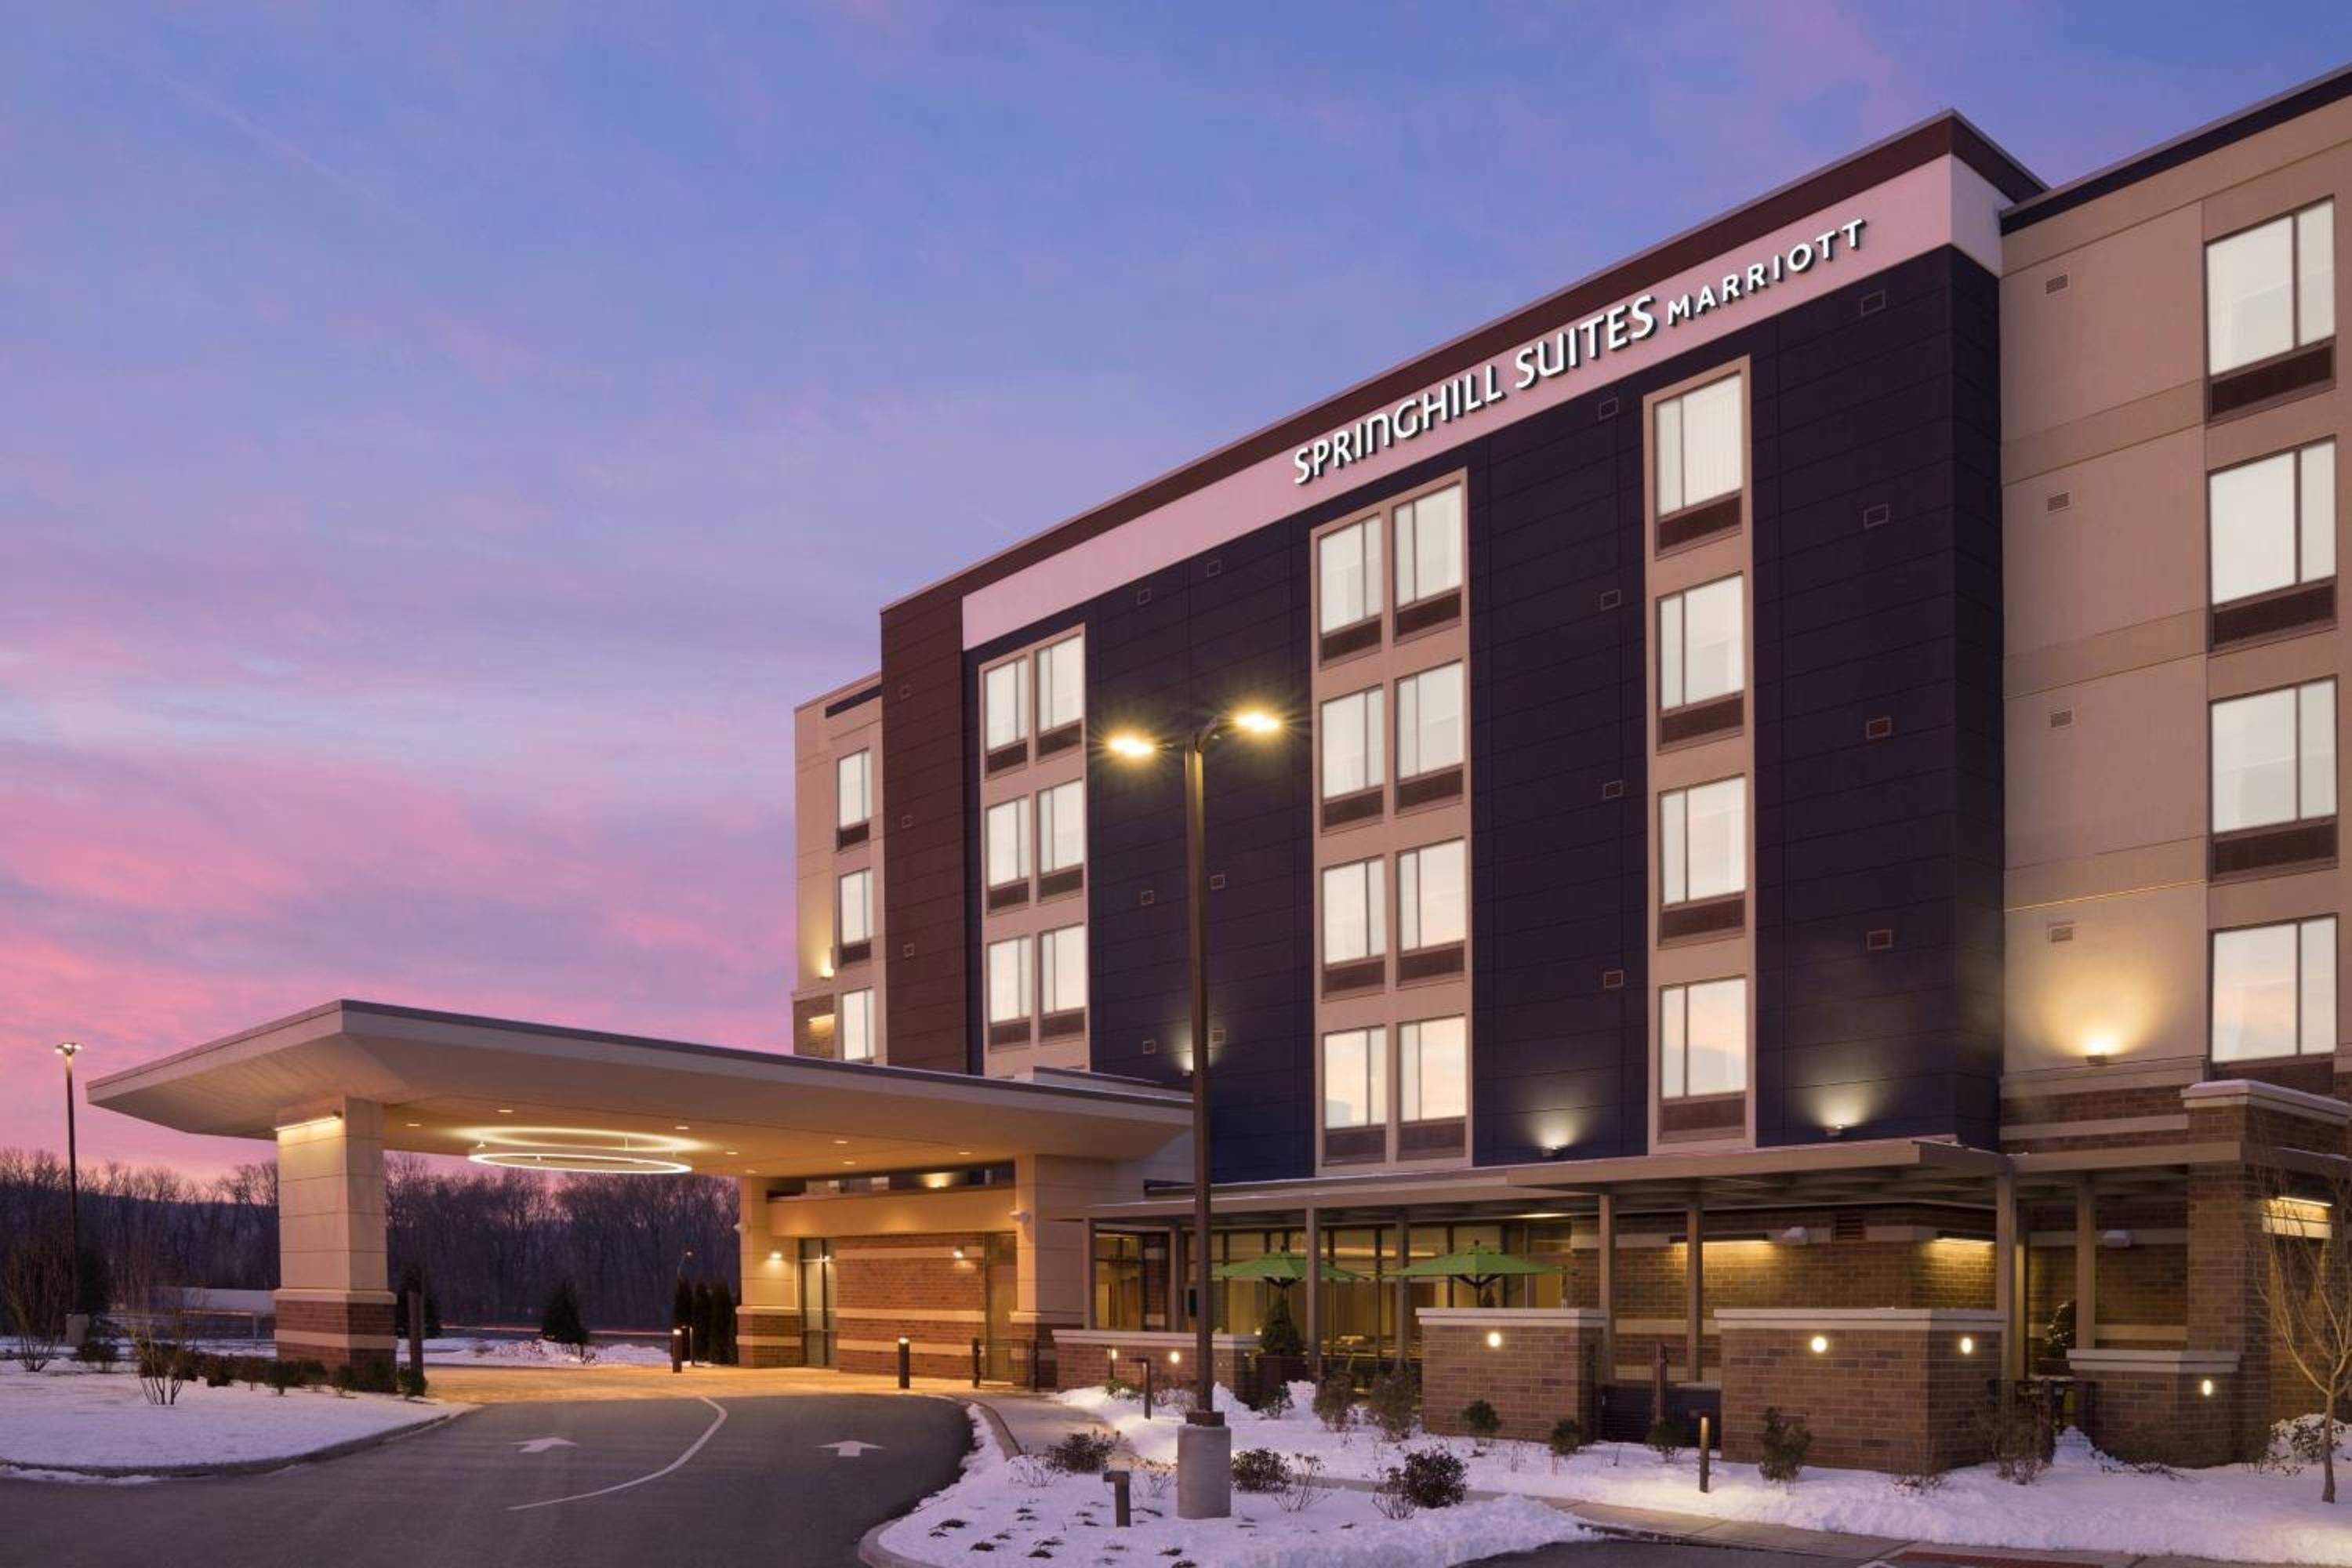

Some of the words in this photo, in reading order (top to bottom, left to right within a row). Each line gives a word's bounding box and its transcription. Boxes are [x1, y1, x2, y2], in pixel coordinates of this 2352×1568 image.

[1294, 365, 1504, 485] SPRINGHILL
[1515, 294, 1656, 389] SUITES
[1668, 219, 1865, 326] MARRIOTT
